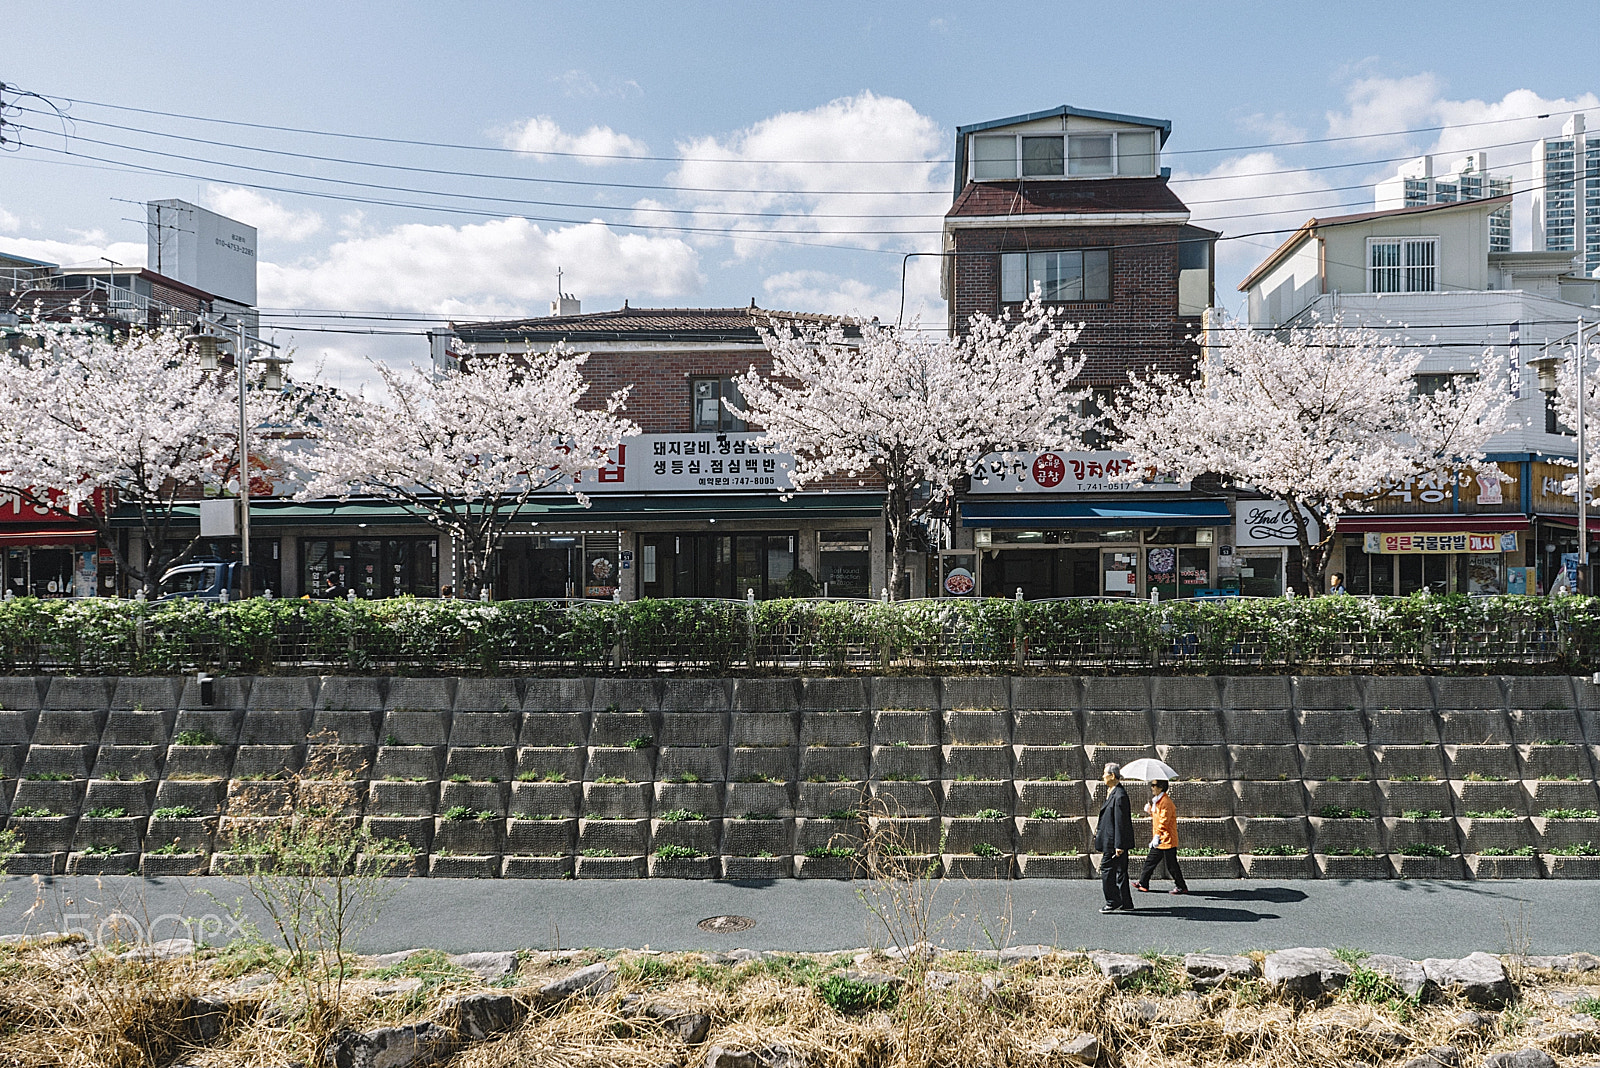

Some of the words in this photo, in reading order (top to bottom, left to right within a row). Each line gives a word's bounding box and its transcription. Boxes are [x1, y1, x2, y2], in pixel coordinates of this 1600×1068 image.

[1037, 470, 1060, 484] 곱창
[1244, 508, 1281, 525] And
[1470, 537, 1494, 550] 개시
